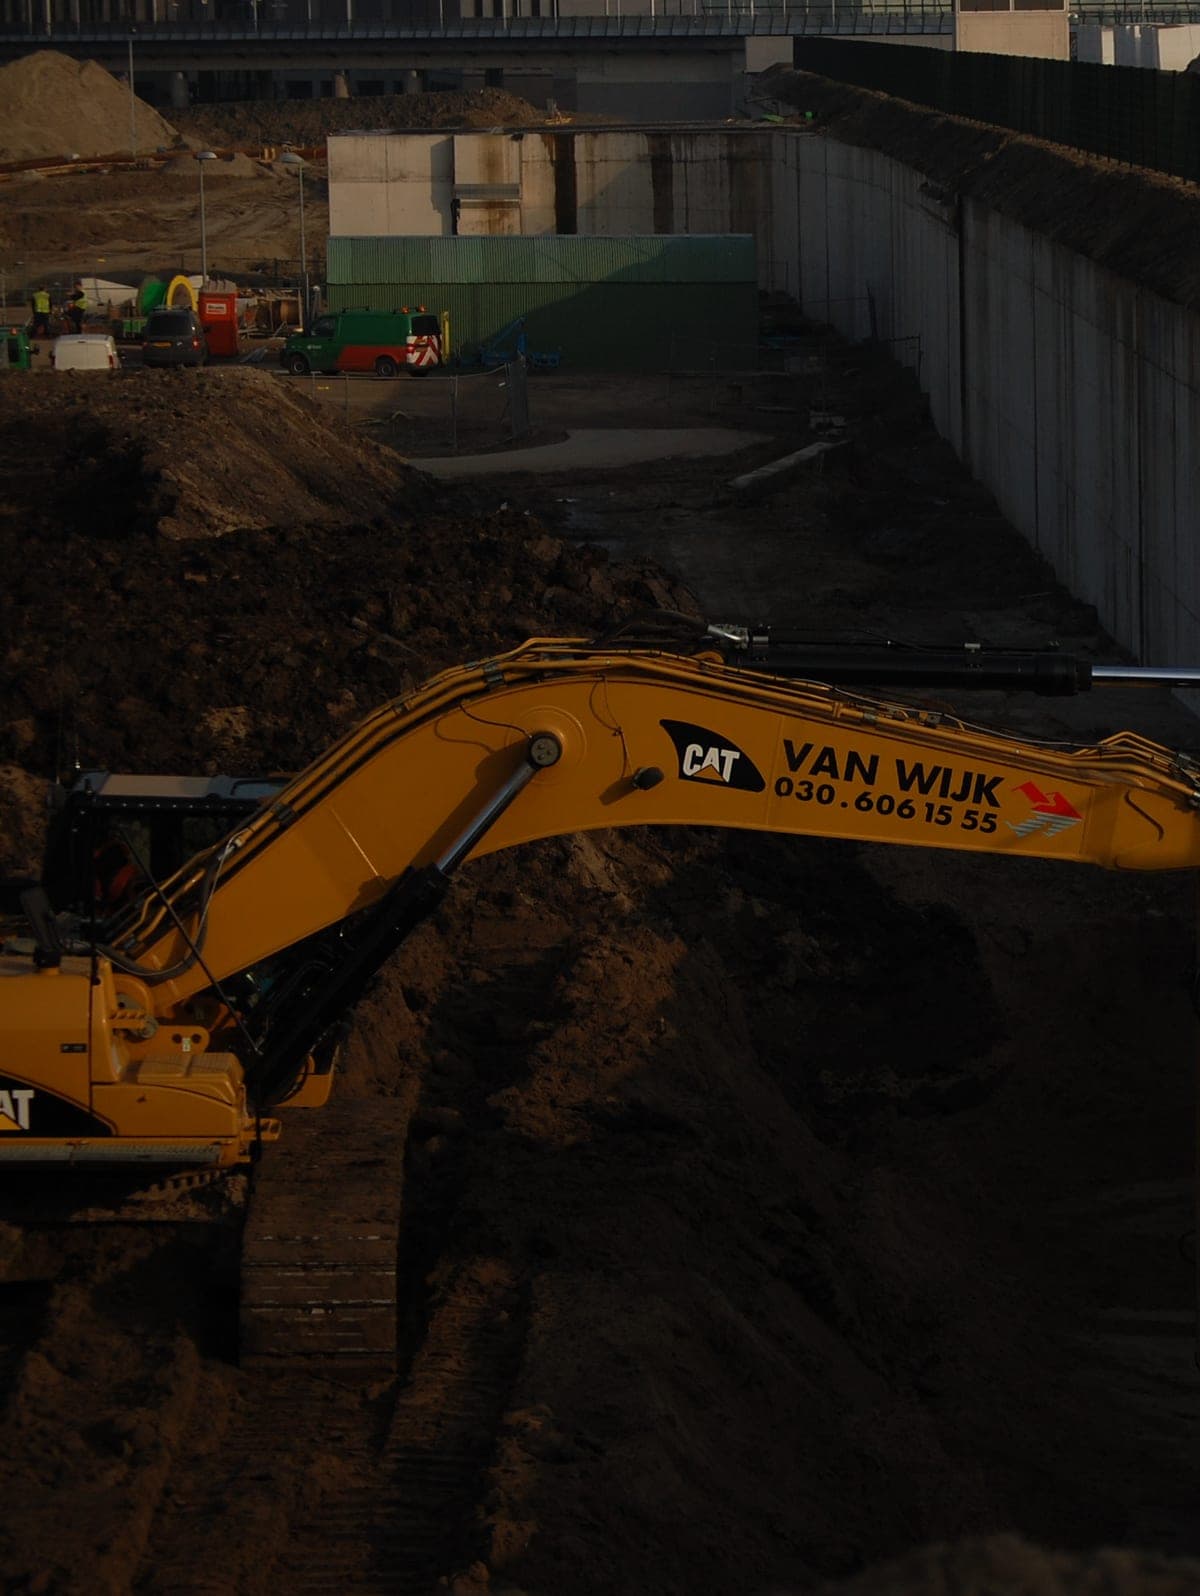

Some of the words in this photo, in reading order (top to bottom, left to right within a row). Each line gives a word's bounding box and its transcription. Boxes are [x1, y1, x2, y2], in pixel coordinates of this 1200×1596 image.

[682, 743, 742, 784] CAT
[783, 739, 879, 785] VAN
[896, 758, 1005, 808] WIJK
[925, 802, 953, 826] 15
[961, 809, 998, 834] 55
